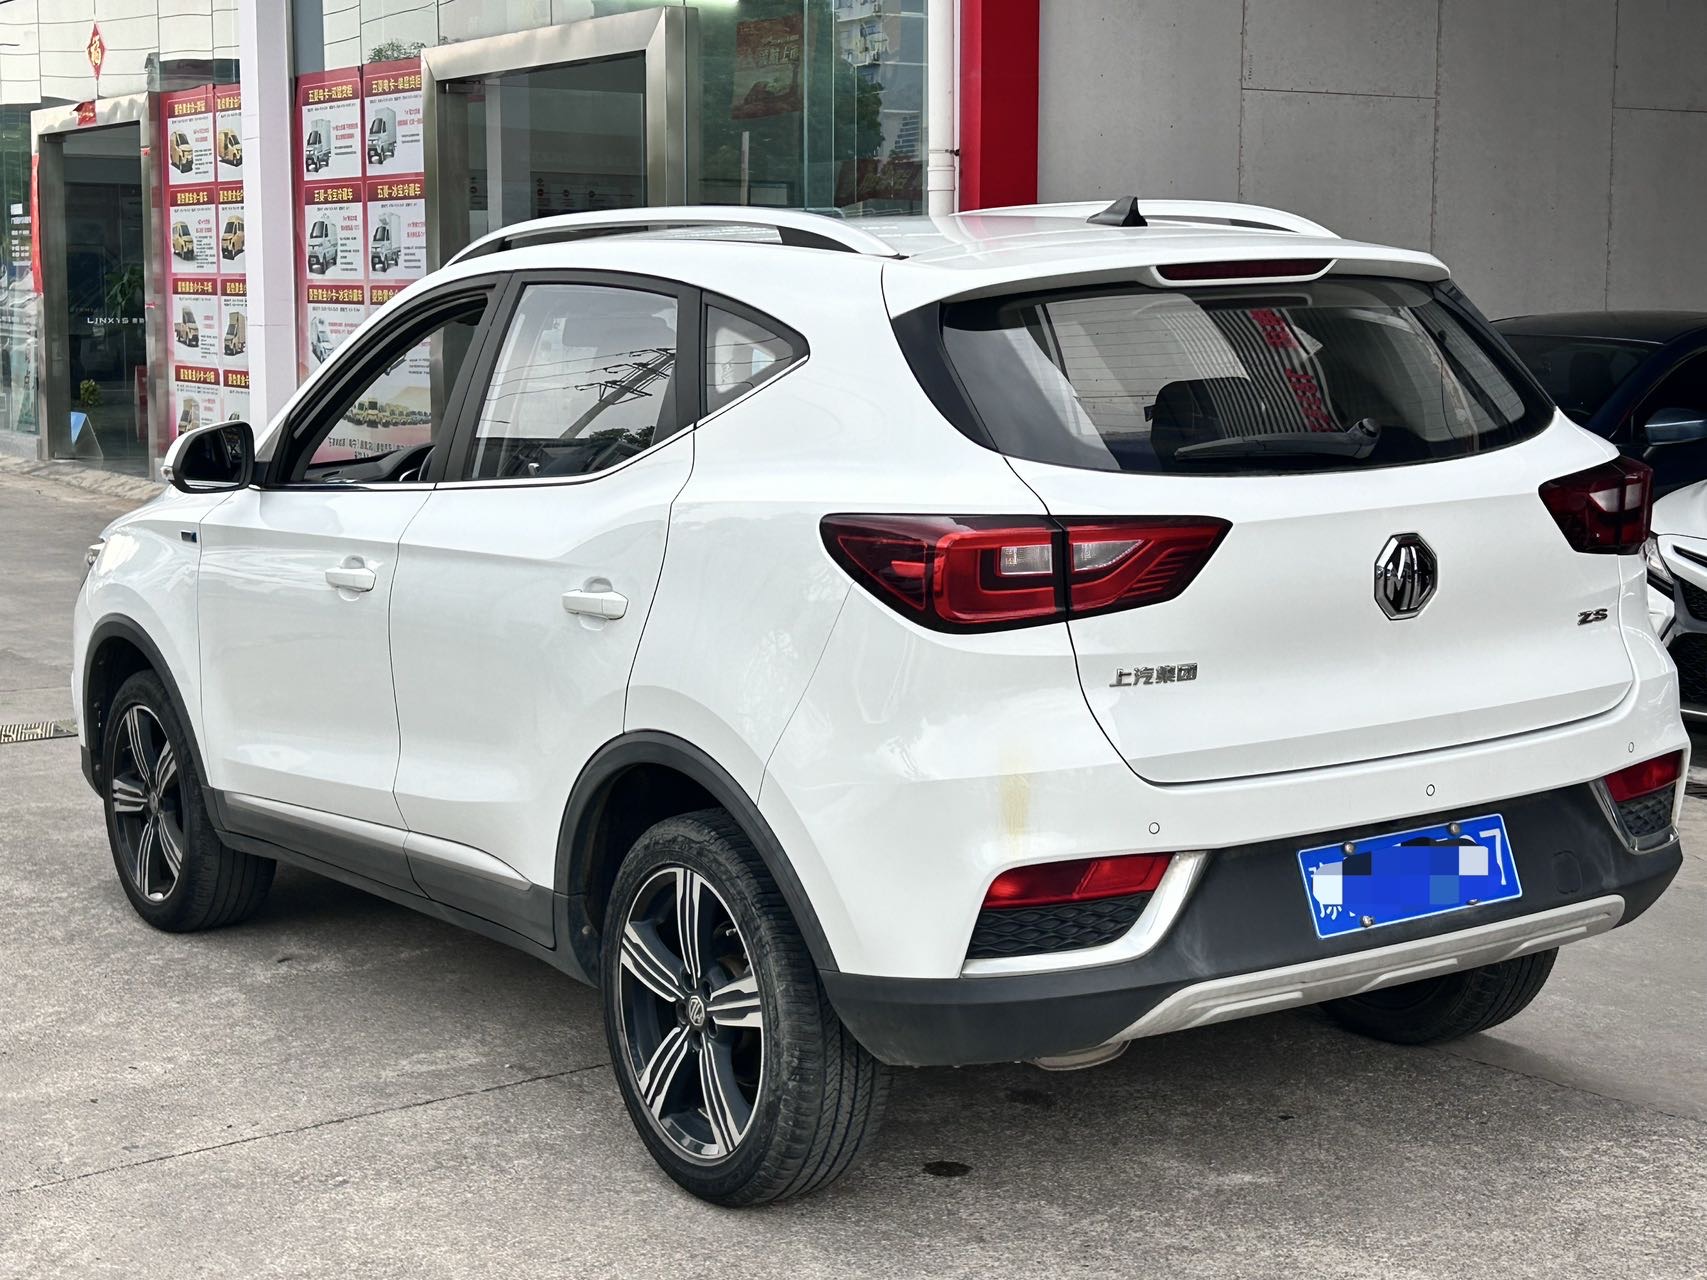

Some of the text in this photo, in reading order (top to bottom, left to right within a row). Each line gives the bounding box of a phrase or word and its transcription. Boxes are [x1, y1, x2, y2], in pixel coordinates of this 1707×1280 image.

[1577, 608, 1608, 626] ZS
[1109, 662, 1198, 688] 上汽集团
